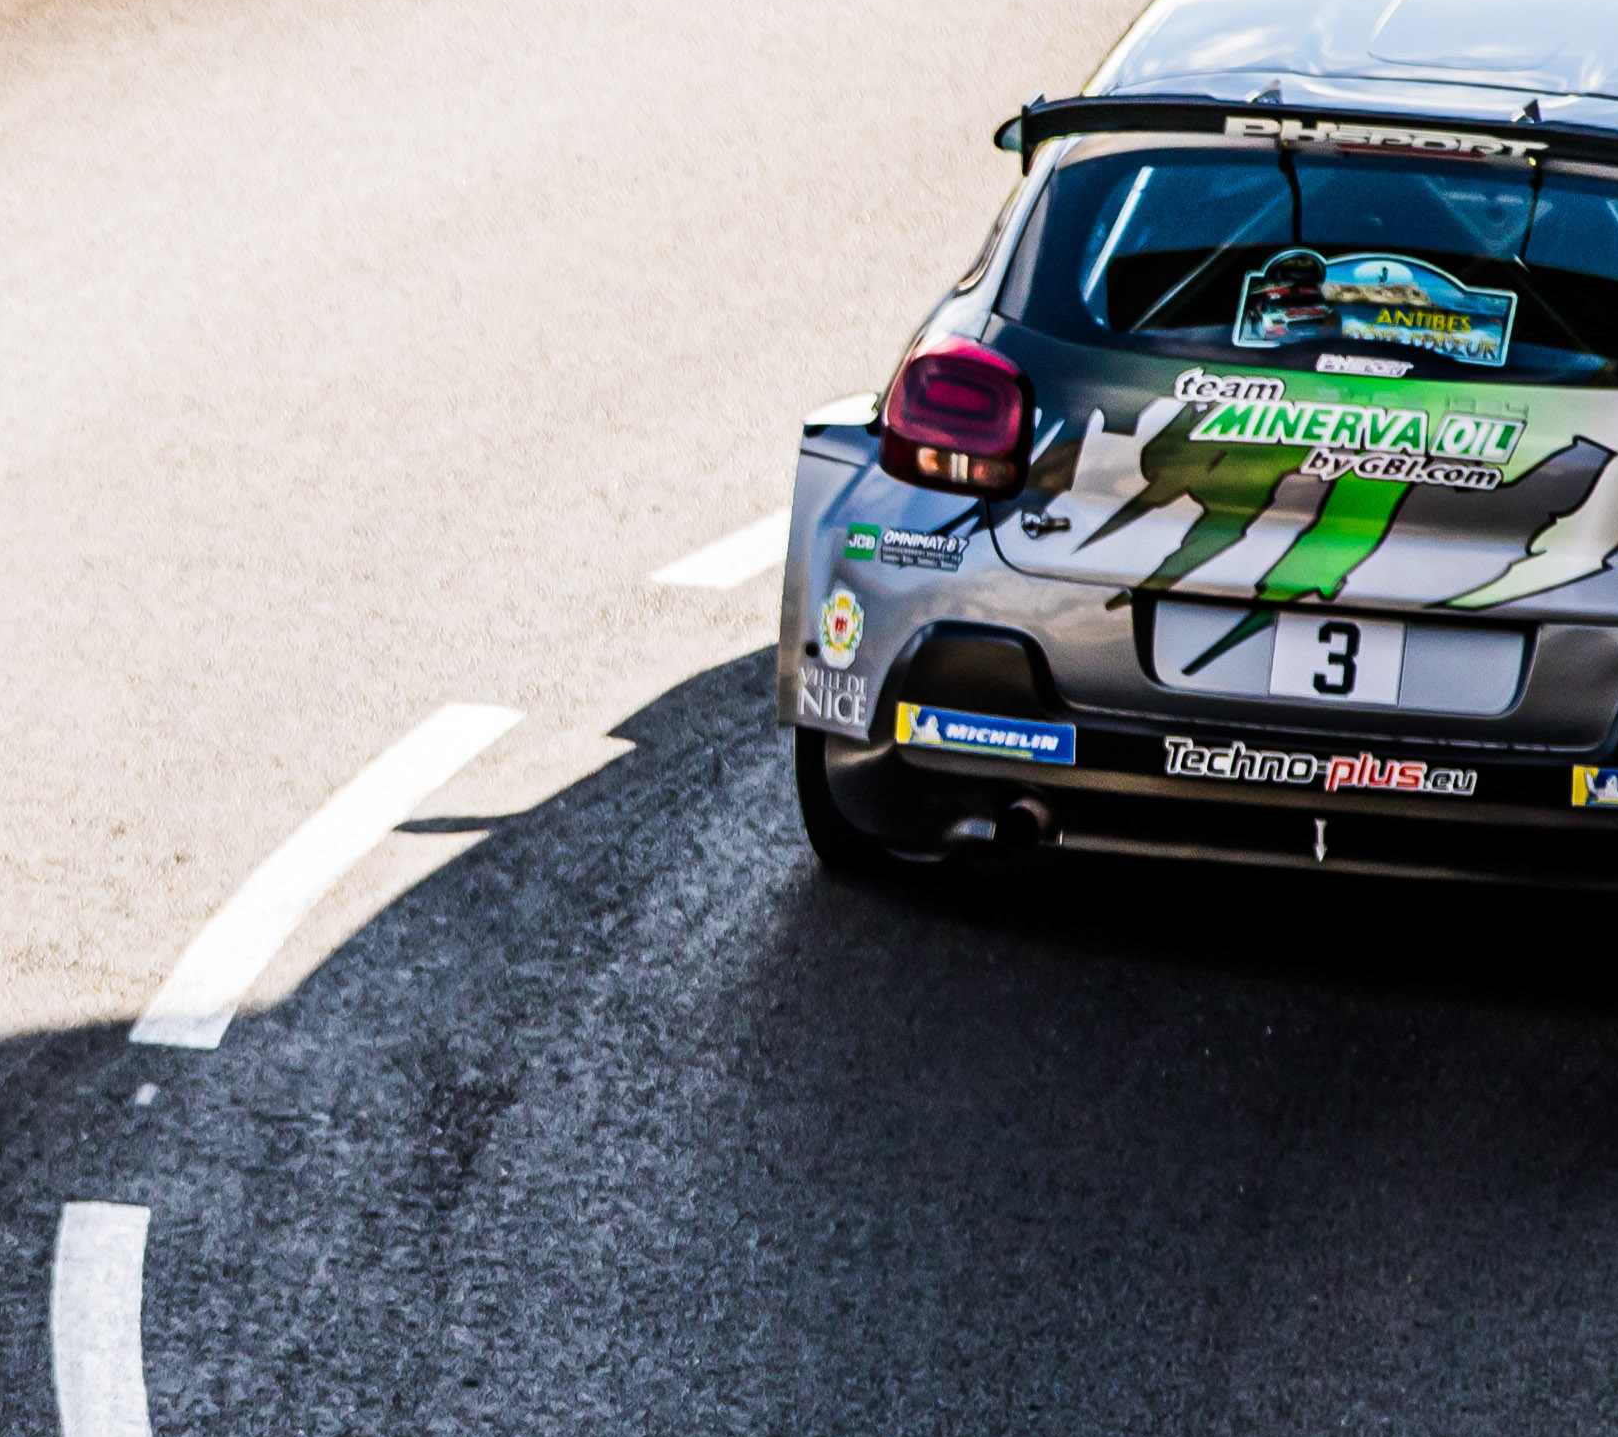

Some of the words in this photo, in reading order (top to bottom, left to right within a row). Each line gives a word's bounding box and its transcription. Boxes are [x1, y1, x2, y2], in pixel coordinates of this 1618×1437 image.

[1376, 308, 1472, 334] ANTIBES
[1177, 369, 1284, 401] team
[1194, 402, 1428, 452] MINERVA
[1439, 417, 1516, 457] OIL
[1313, 620, 1361, 696] 3
[797, 686, 867, 726] NICE
[945, 722, 1060, 752] MICHELIN
[1164, 735, 1478, 797] Techno-plus.eu
